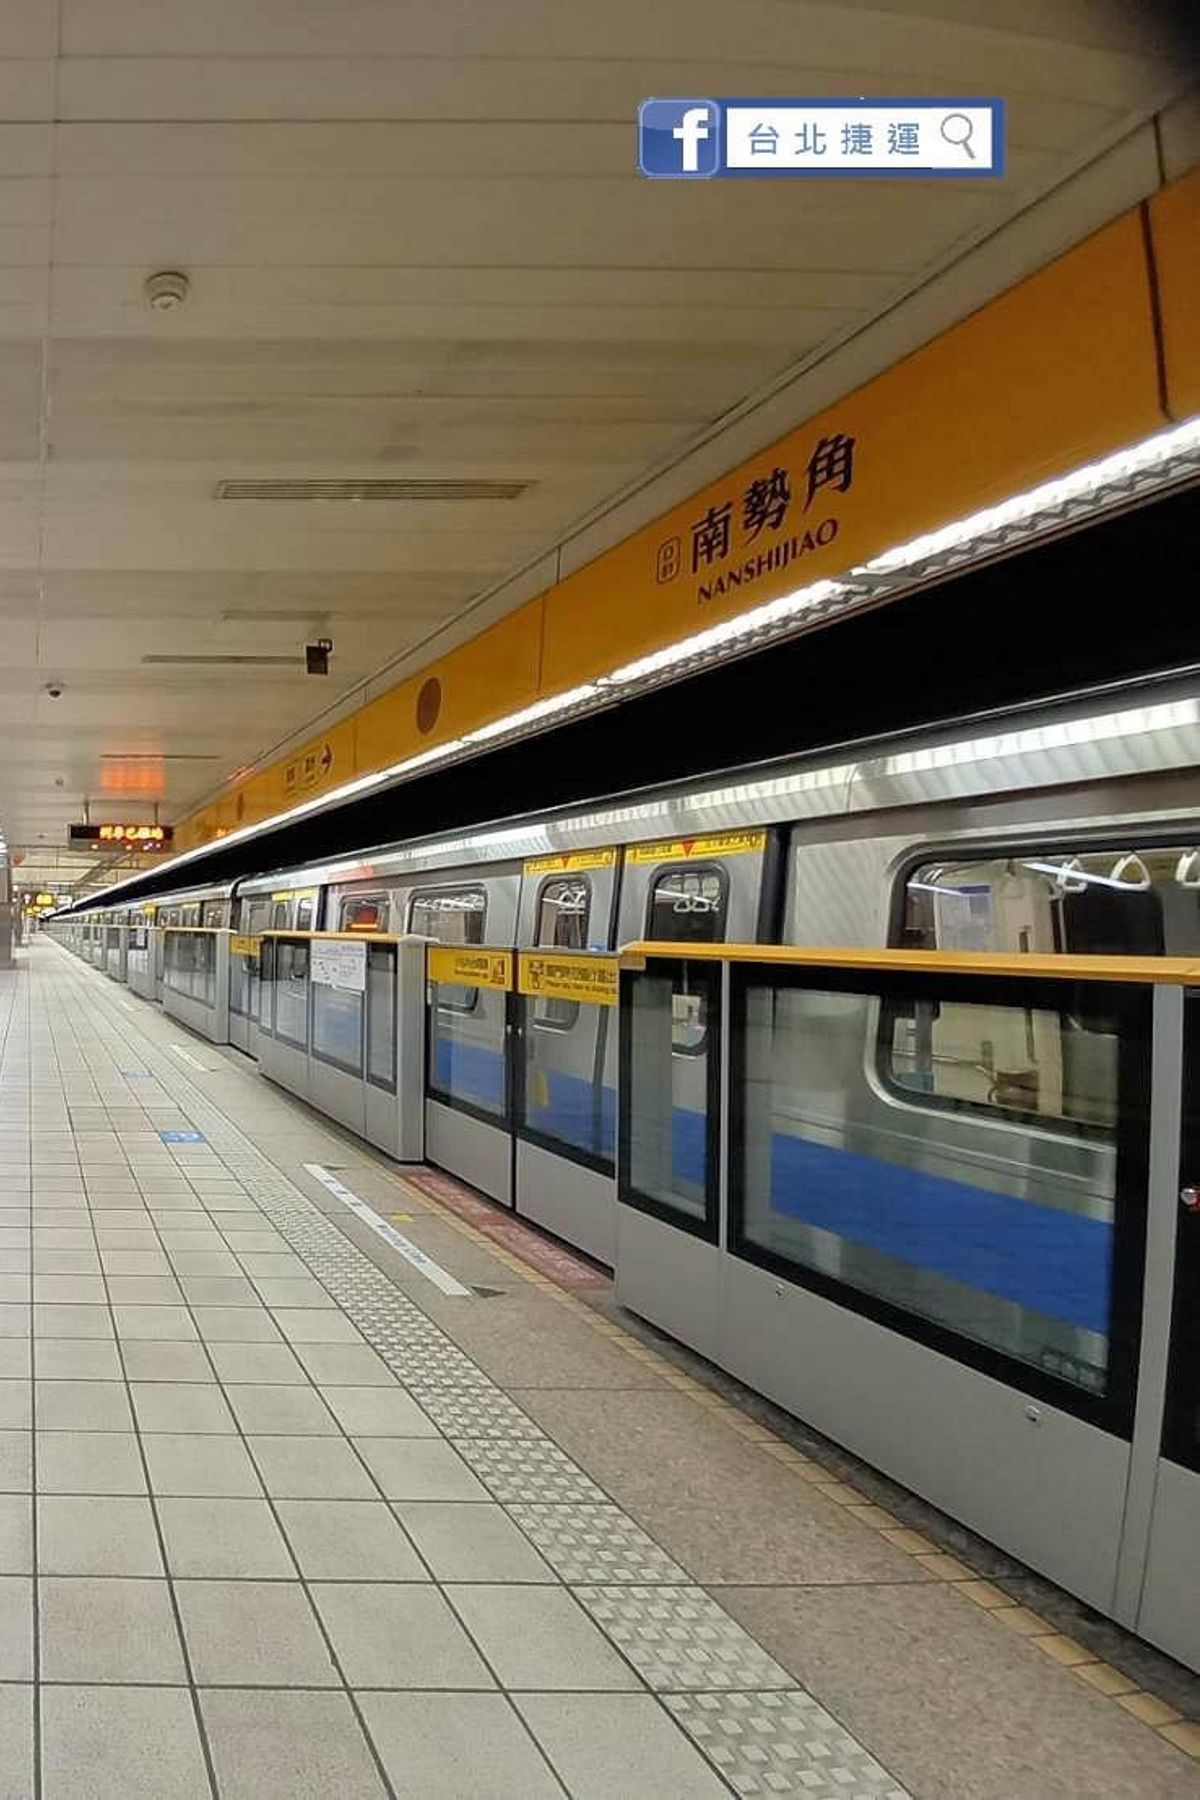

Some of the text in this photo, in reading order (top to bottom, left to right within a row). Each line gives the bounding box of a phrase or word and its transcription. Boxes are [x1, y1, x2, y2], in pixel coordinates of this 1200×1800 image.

[691, 433, 856, 574] 南勢角
[698, 519, 839, 604] NANSHIJIAO
